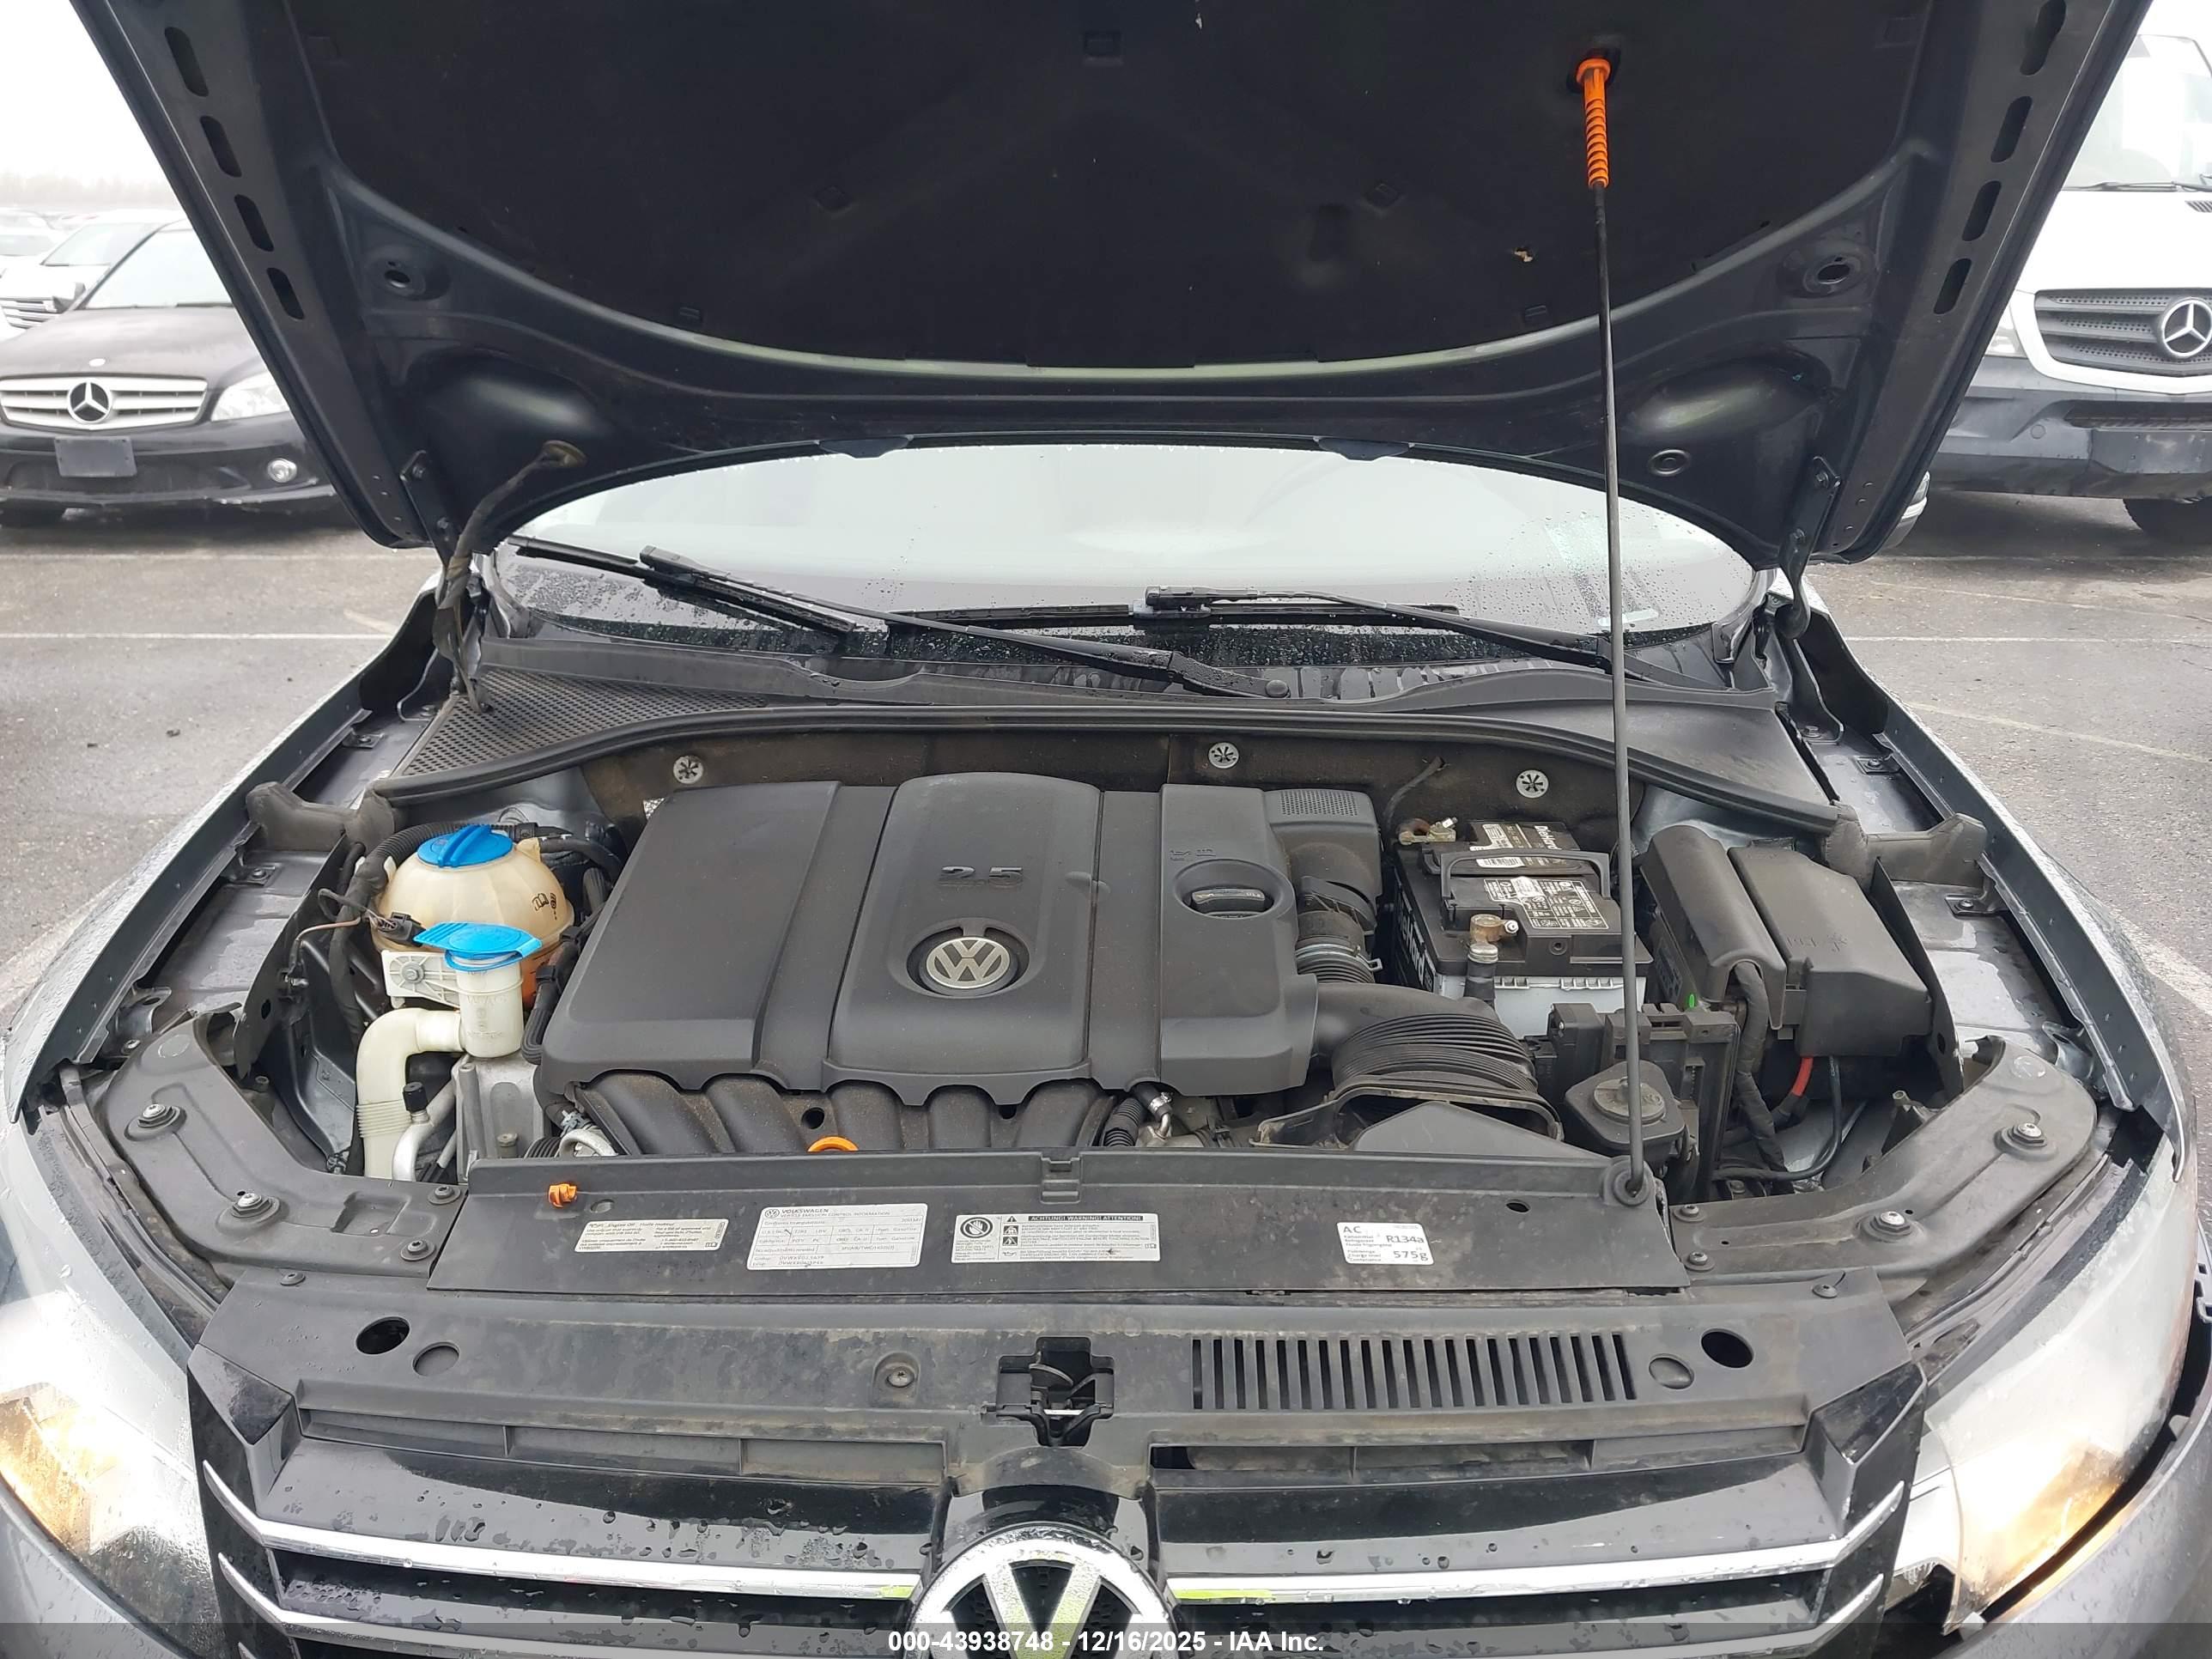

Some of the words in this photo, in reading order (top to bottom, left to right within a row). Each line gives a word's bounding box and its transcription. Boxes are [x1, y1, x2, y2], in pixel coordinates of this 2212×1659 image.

[1534, 825, 1563, 850] DieHard
[927, 936, 1011, 989] VW
[1343, 1225, 1362, 1234] AC
[1386, 1235, 1425, 1243] R134a
